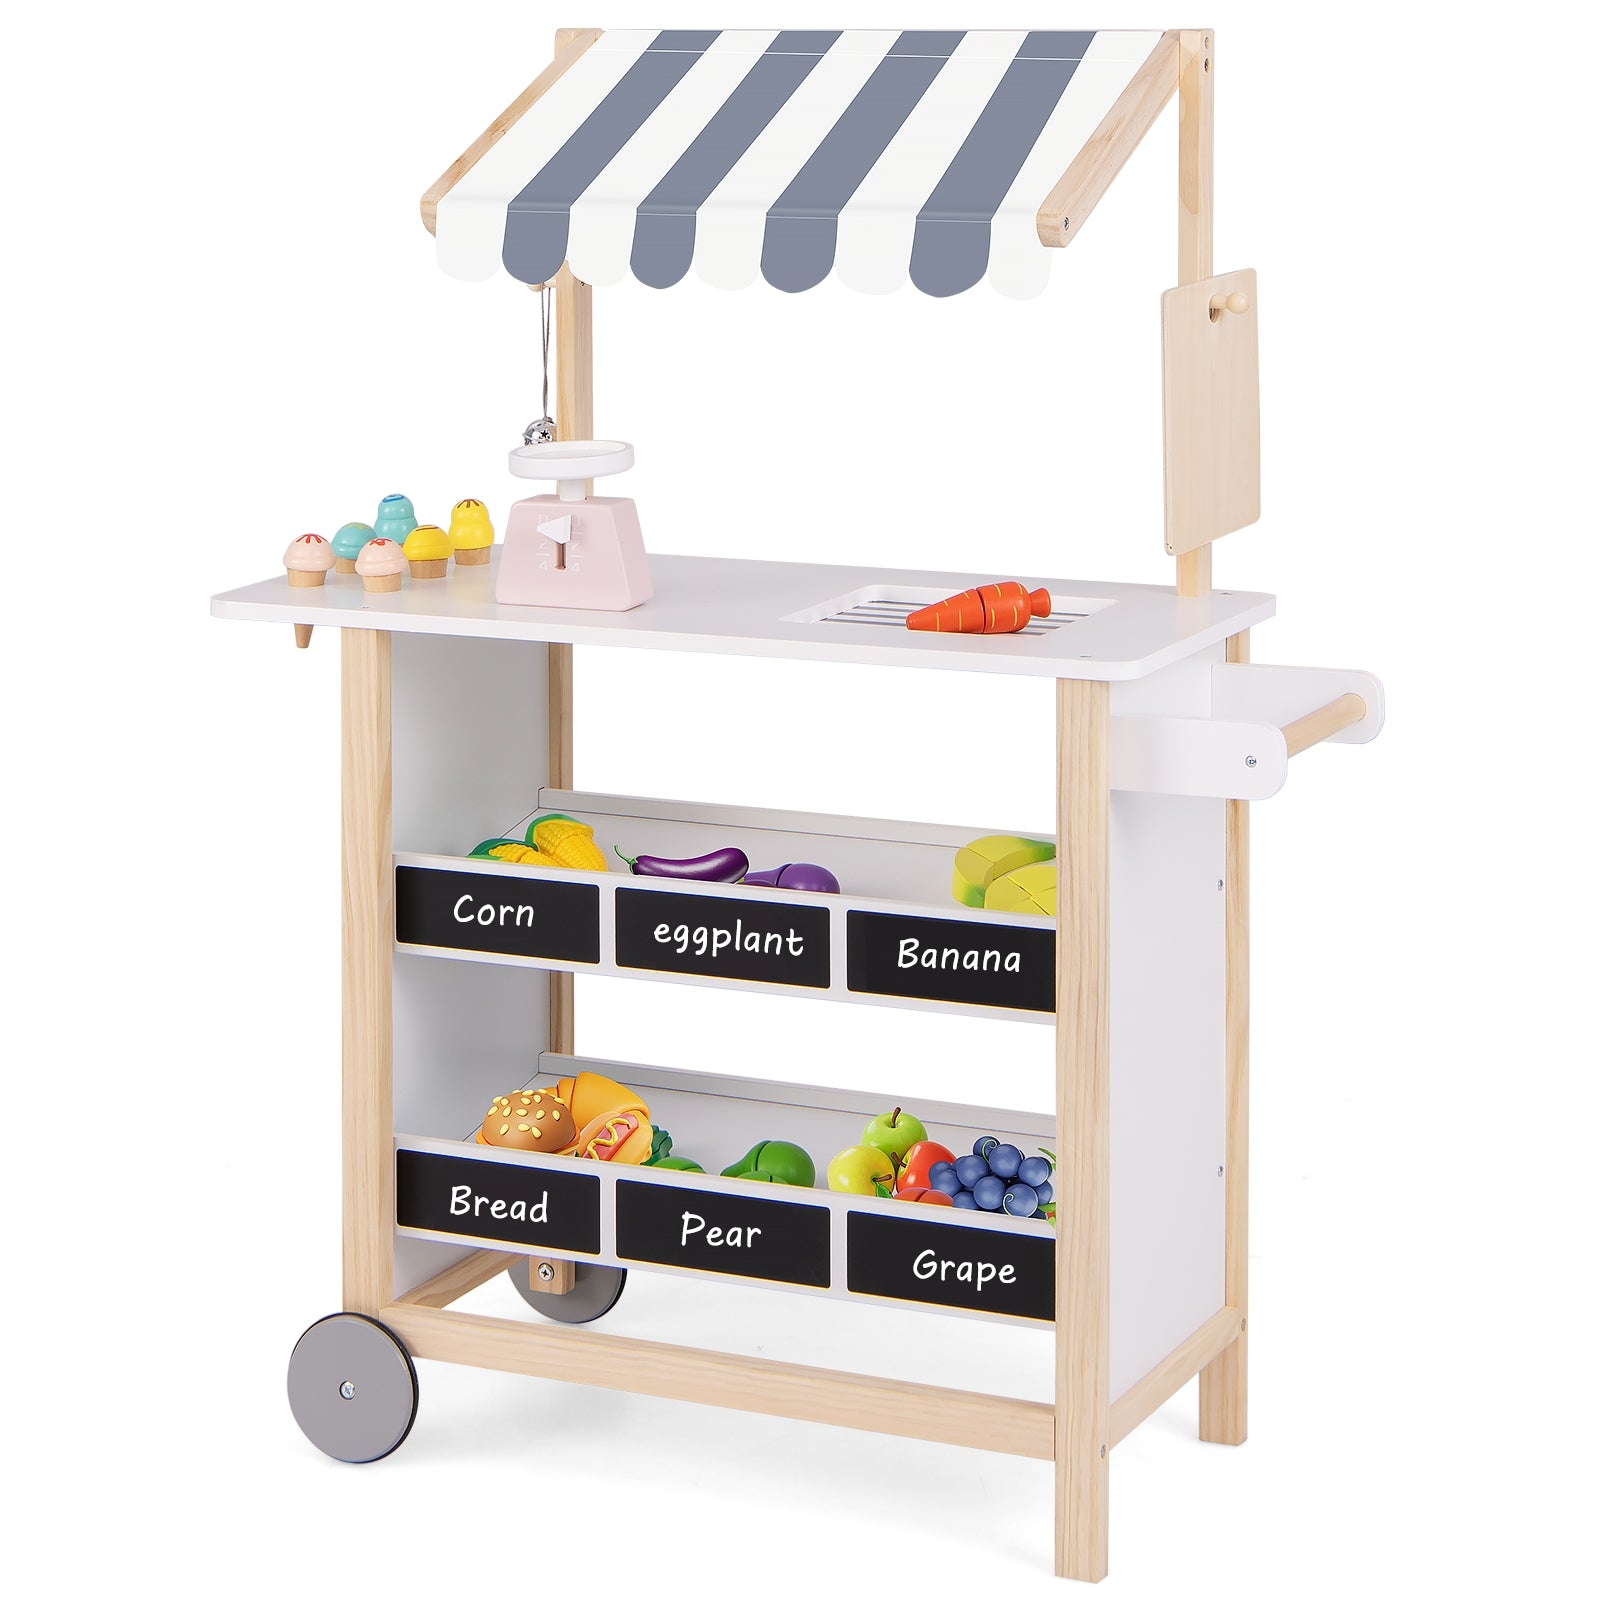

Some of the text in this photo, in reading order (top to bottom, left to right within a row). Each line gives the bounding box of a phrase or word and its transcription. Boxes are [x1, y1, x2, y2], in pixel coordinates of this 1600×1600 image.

[570, 562, 580, 573] 4
[454, 895, 534, 928] Corn
[653, 919, 804, 957] eggplant
[897, 938, 1021, 973] Banana
[449, 1185, 548, 1224] Bread
[680, 1211, 761, 1248] Pear
[912, 1249, 1017, 1291] Grape
